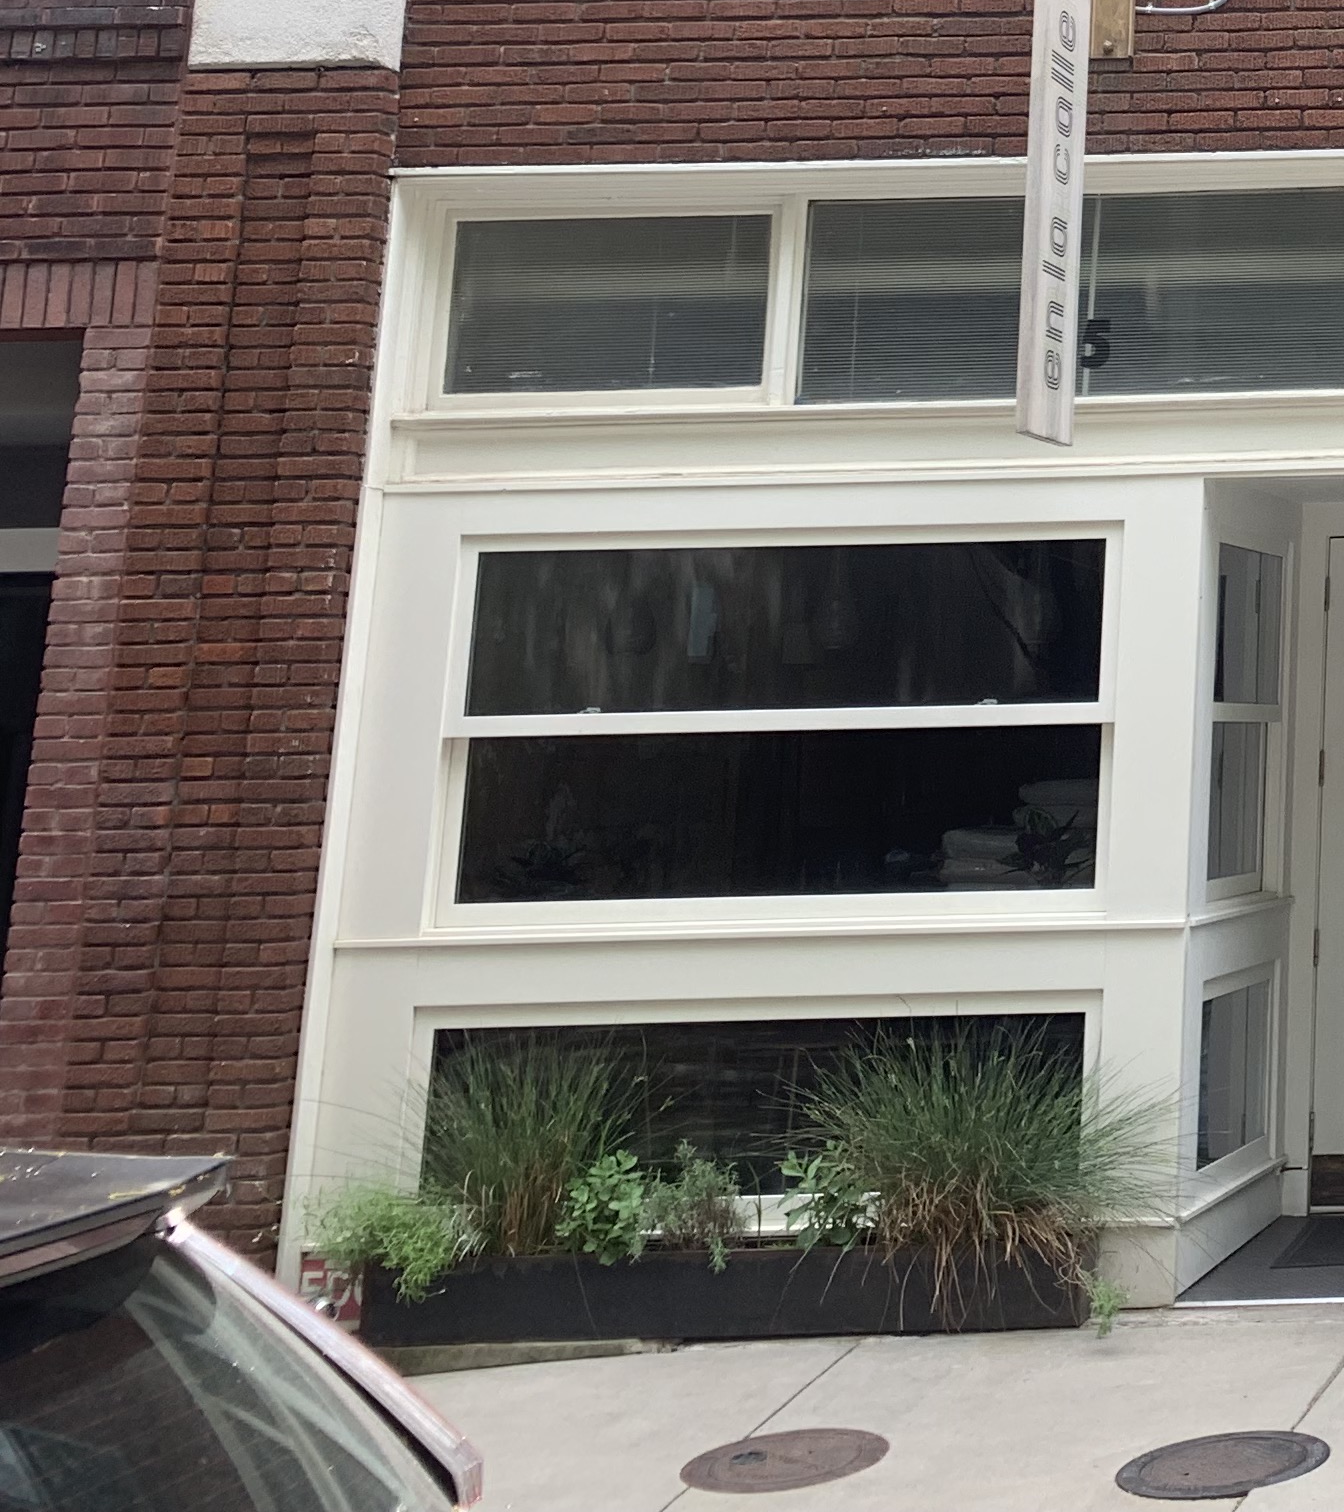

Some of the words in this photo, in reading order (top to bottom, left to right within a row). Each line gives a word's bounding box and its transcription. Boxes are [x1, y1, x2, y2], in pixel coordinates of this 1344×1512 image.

[1050, 10, 1078, 186] calle
[1042, 215, 1069, 282] la
[1042, 300, 1064, 391] en
